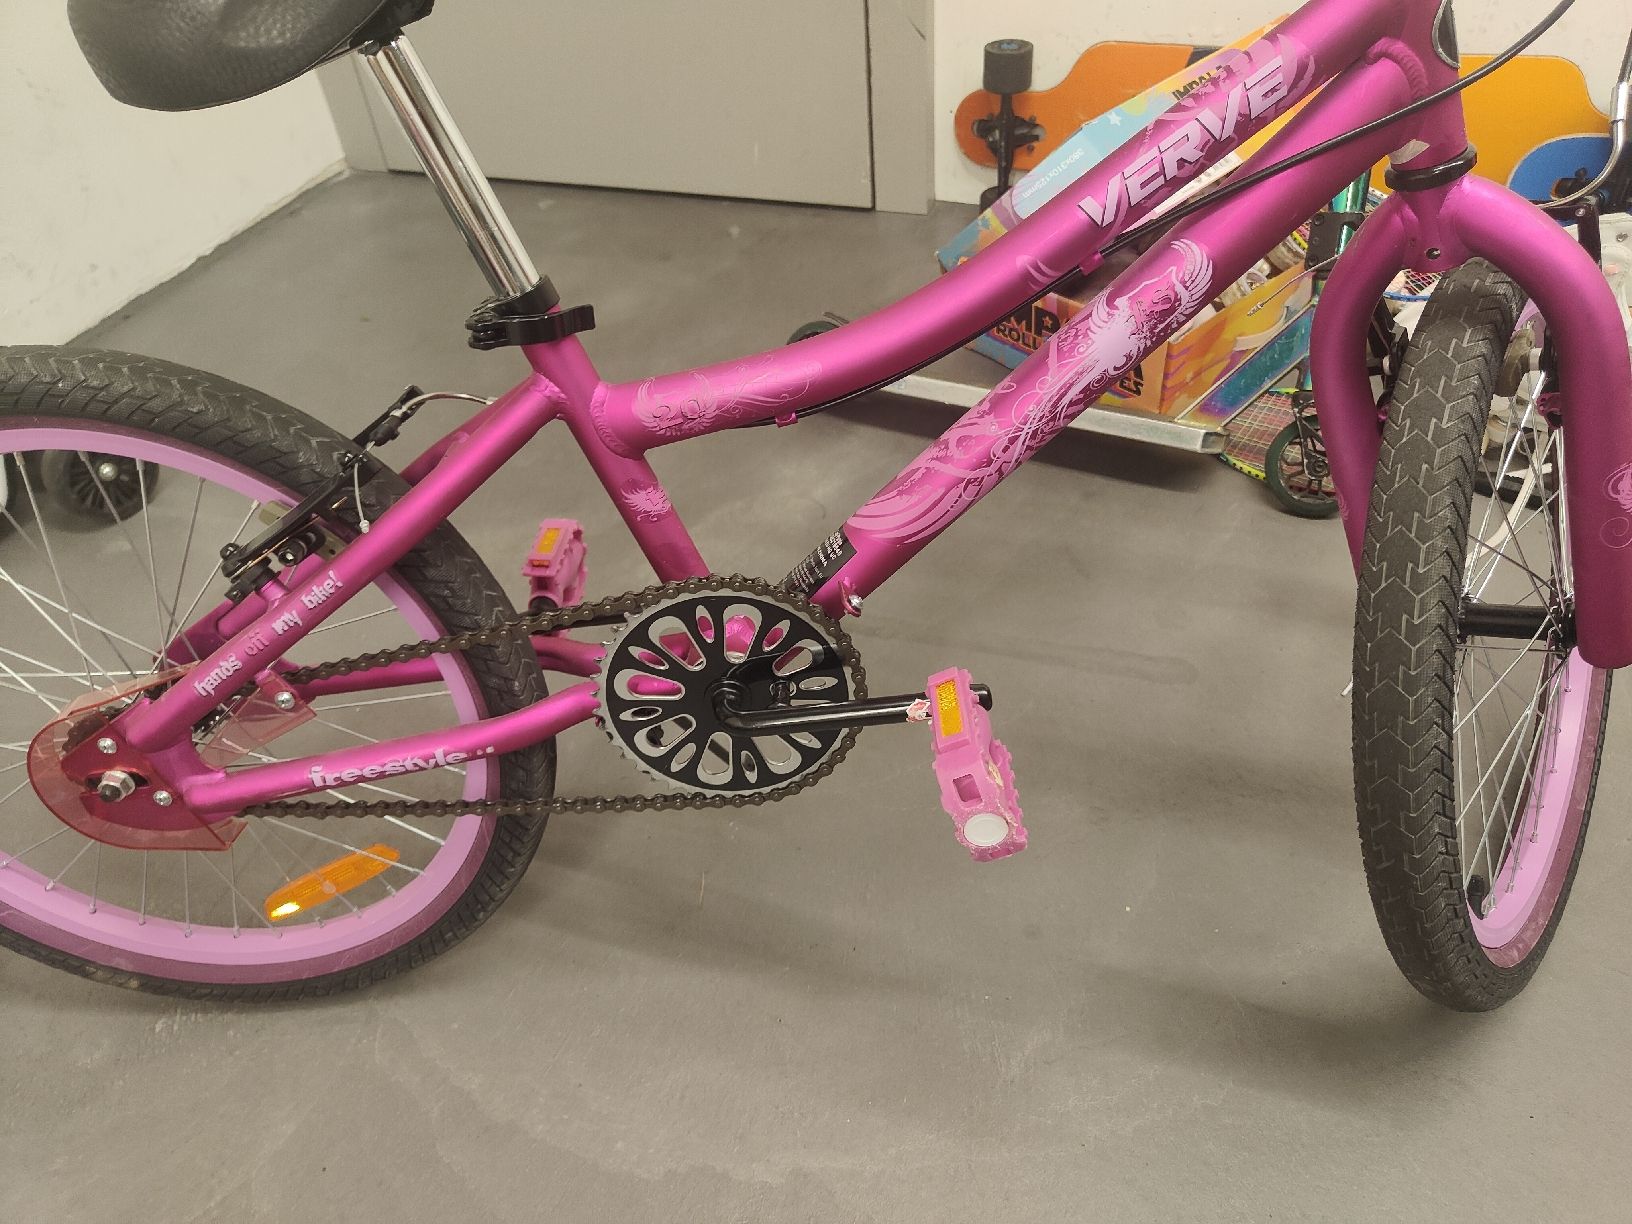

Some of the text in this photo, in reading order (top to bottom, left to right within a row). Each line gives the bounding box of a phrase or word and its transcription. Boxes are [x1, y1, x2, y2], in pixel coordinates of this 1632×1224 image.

[1077, 55, 1288, 227] VERVE
[194, 653, 242, 696] hands
[272, 610, 303, 636] my
[301, 570, 344, 610] bike!
